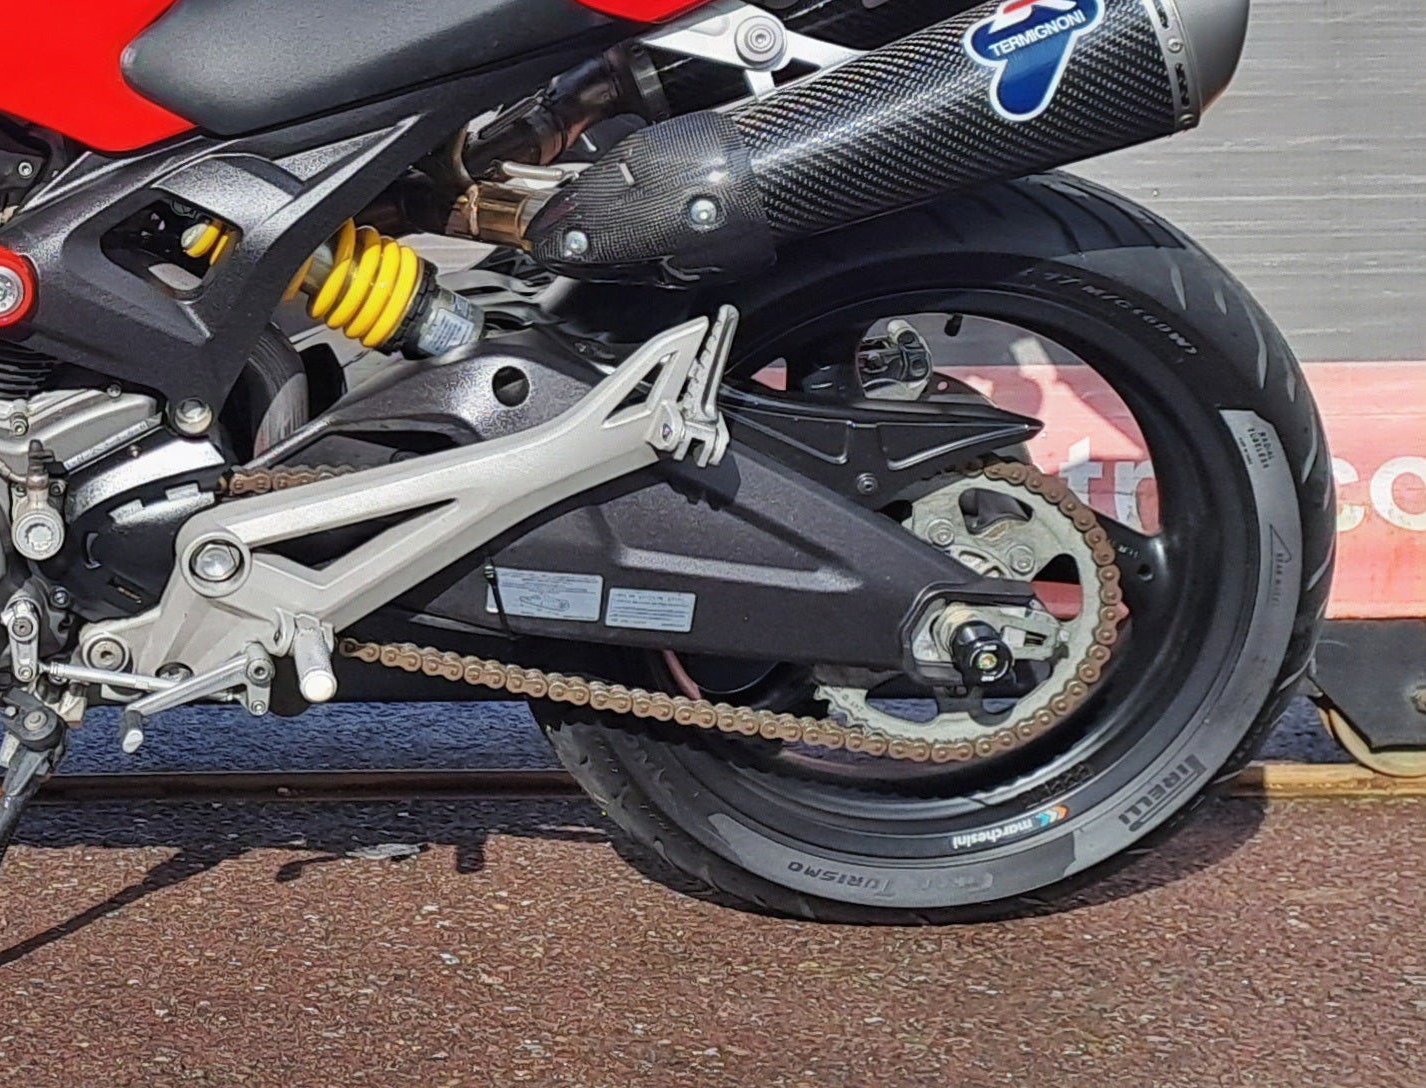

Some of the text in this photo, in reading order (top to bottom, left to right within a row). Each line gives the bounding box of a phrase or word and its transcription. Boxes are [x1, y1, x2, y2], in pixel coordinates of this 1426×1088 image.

[987, 9, 1087, 57] TERMIGNONI
[1118, 753, 1208, 833] PIRELLI
[952, 819, 1033, 849] marchesini
